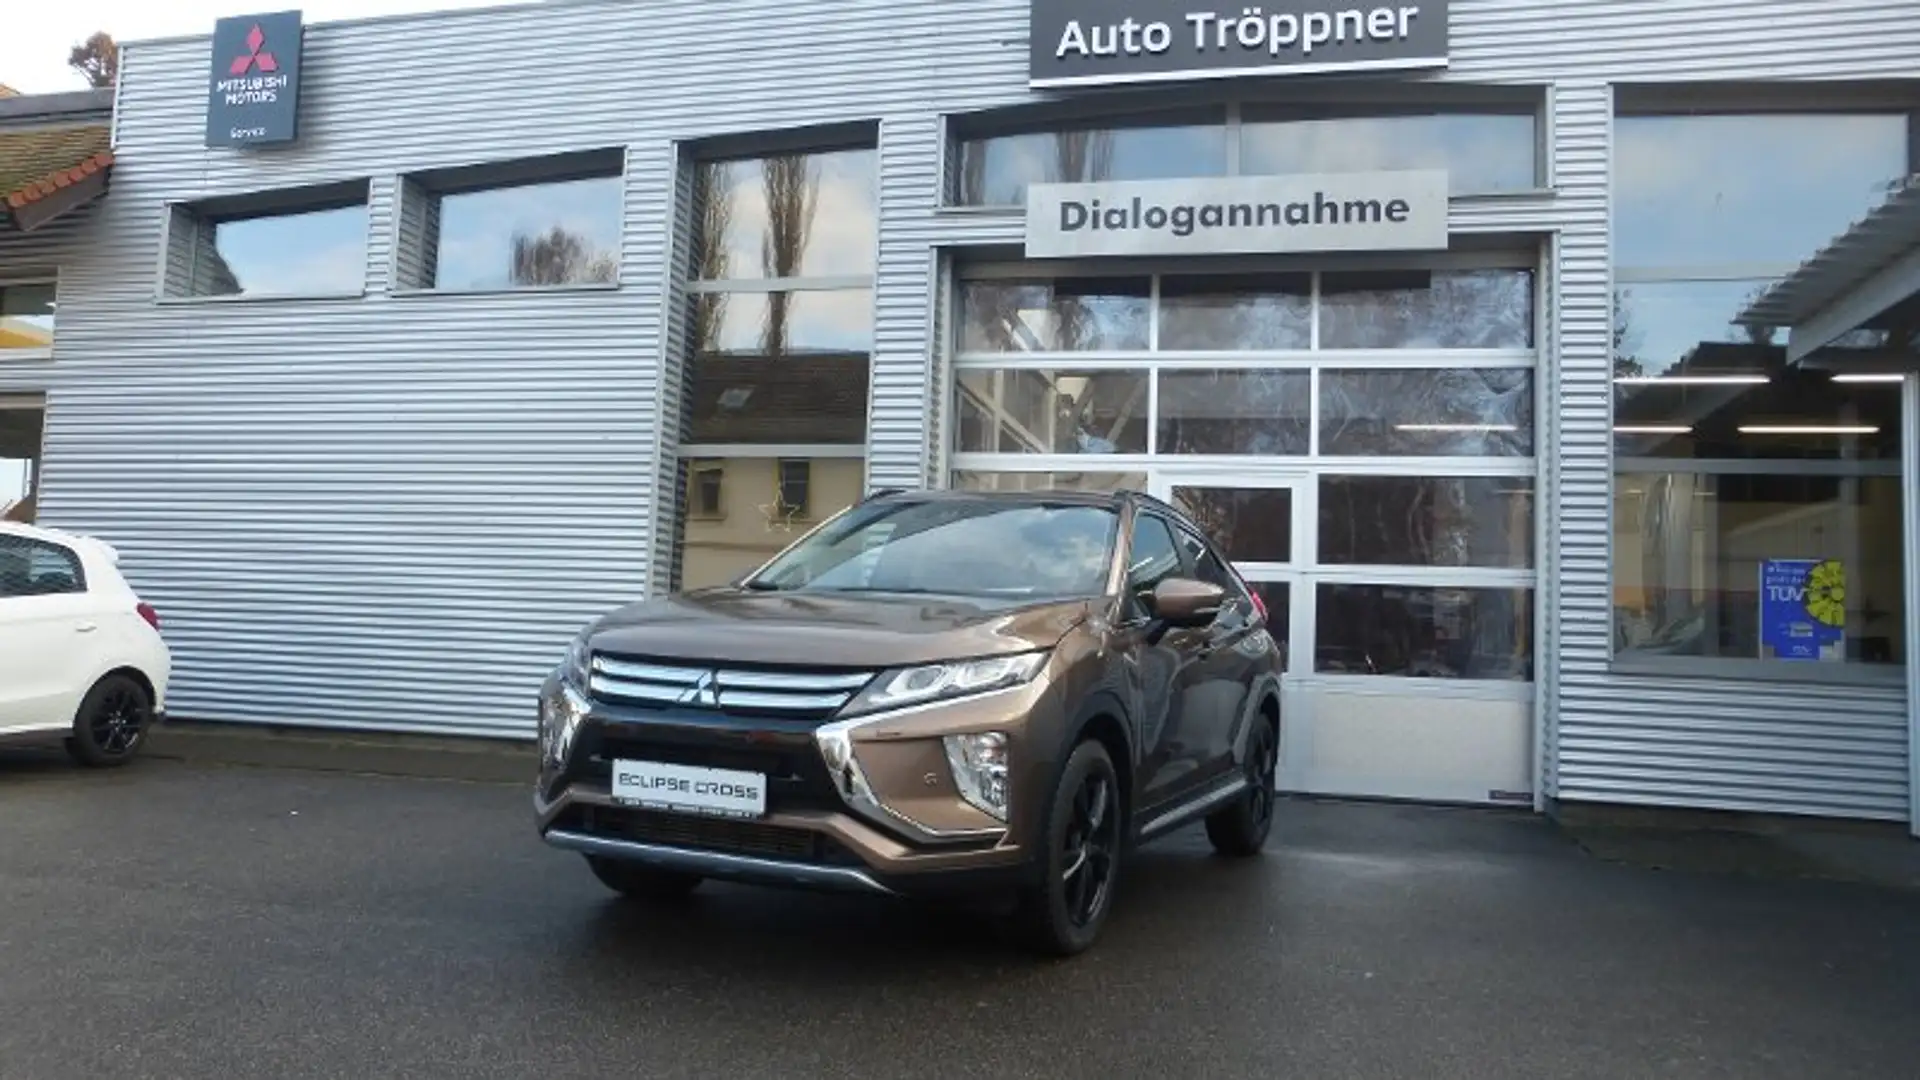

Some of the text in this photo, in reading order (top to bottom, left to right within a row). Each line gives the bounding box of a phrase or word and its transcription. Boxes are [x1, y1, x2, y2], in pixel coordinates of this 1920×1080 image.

[1055, 6, 1419, 57] Auto Tröppner
[216, 75, 287, 92] MITSUBISHI
[225, 89, 277, 105] MOTORS
[1060, 192, 1410, 236] Dialogannahme
[619, 773, 758, 800] ECLIPSE CROSS
